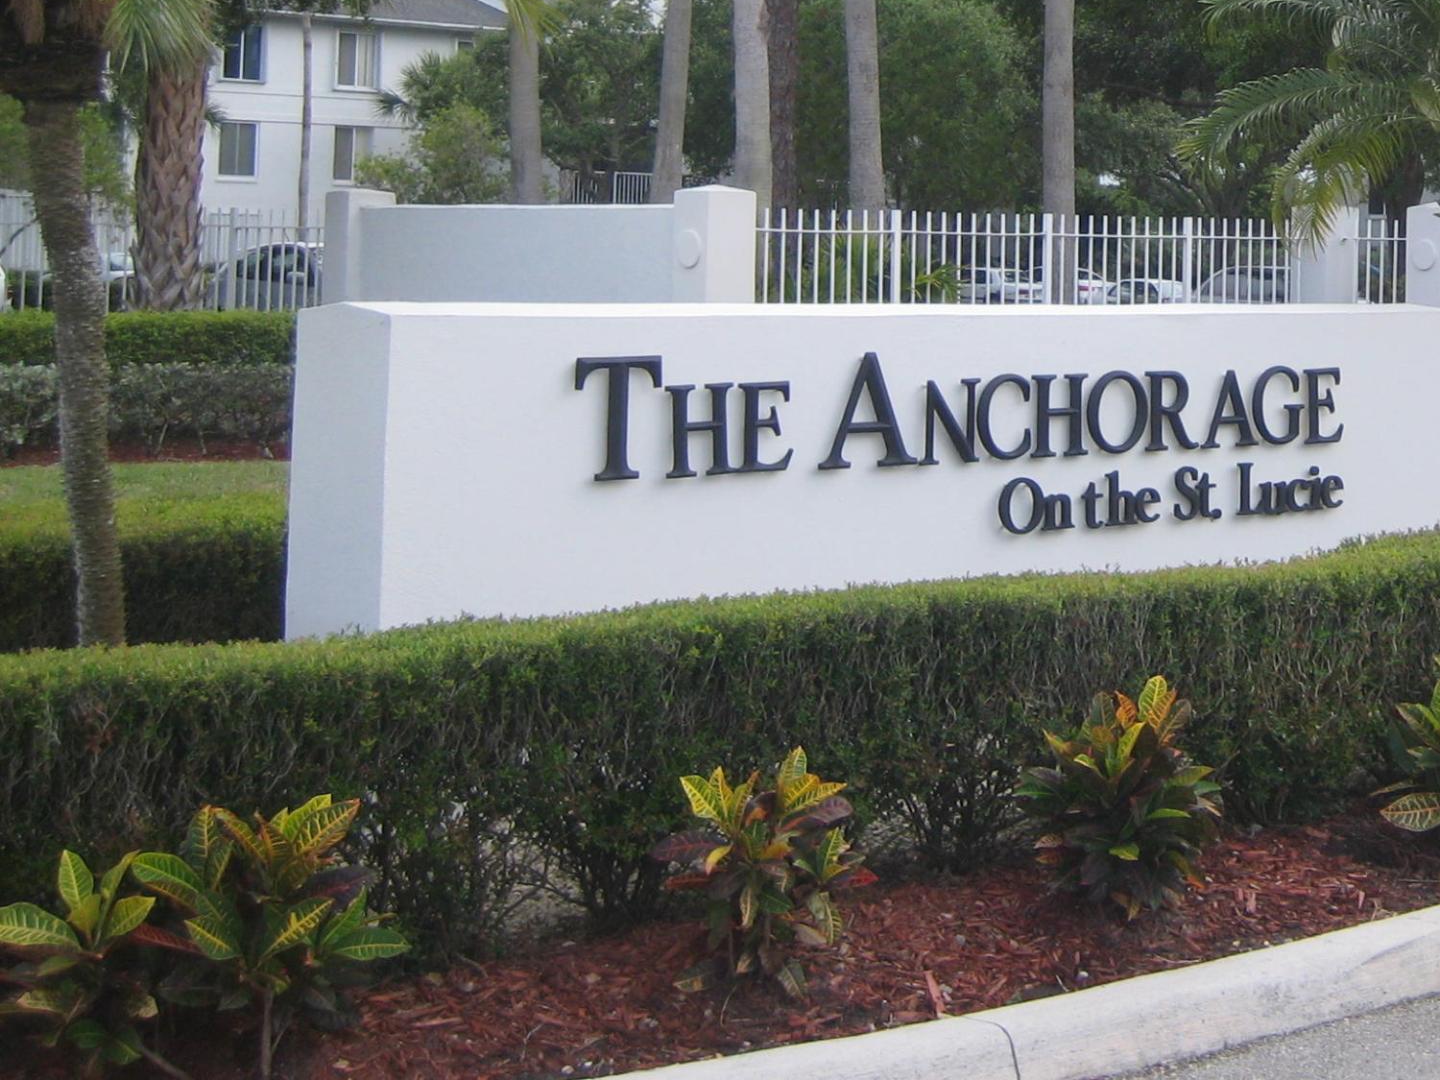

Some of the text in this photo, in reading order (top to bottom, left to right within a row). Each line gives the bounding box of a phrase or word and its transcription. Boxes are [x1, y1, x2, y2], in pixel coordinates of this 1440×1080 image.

[574, 352, 1345, 483] THE ANCHORAGE
[997, 462, 1345, 535] On the St. Lucie
